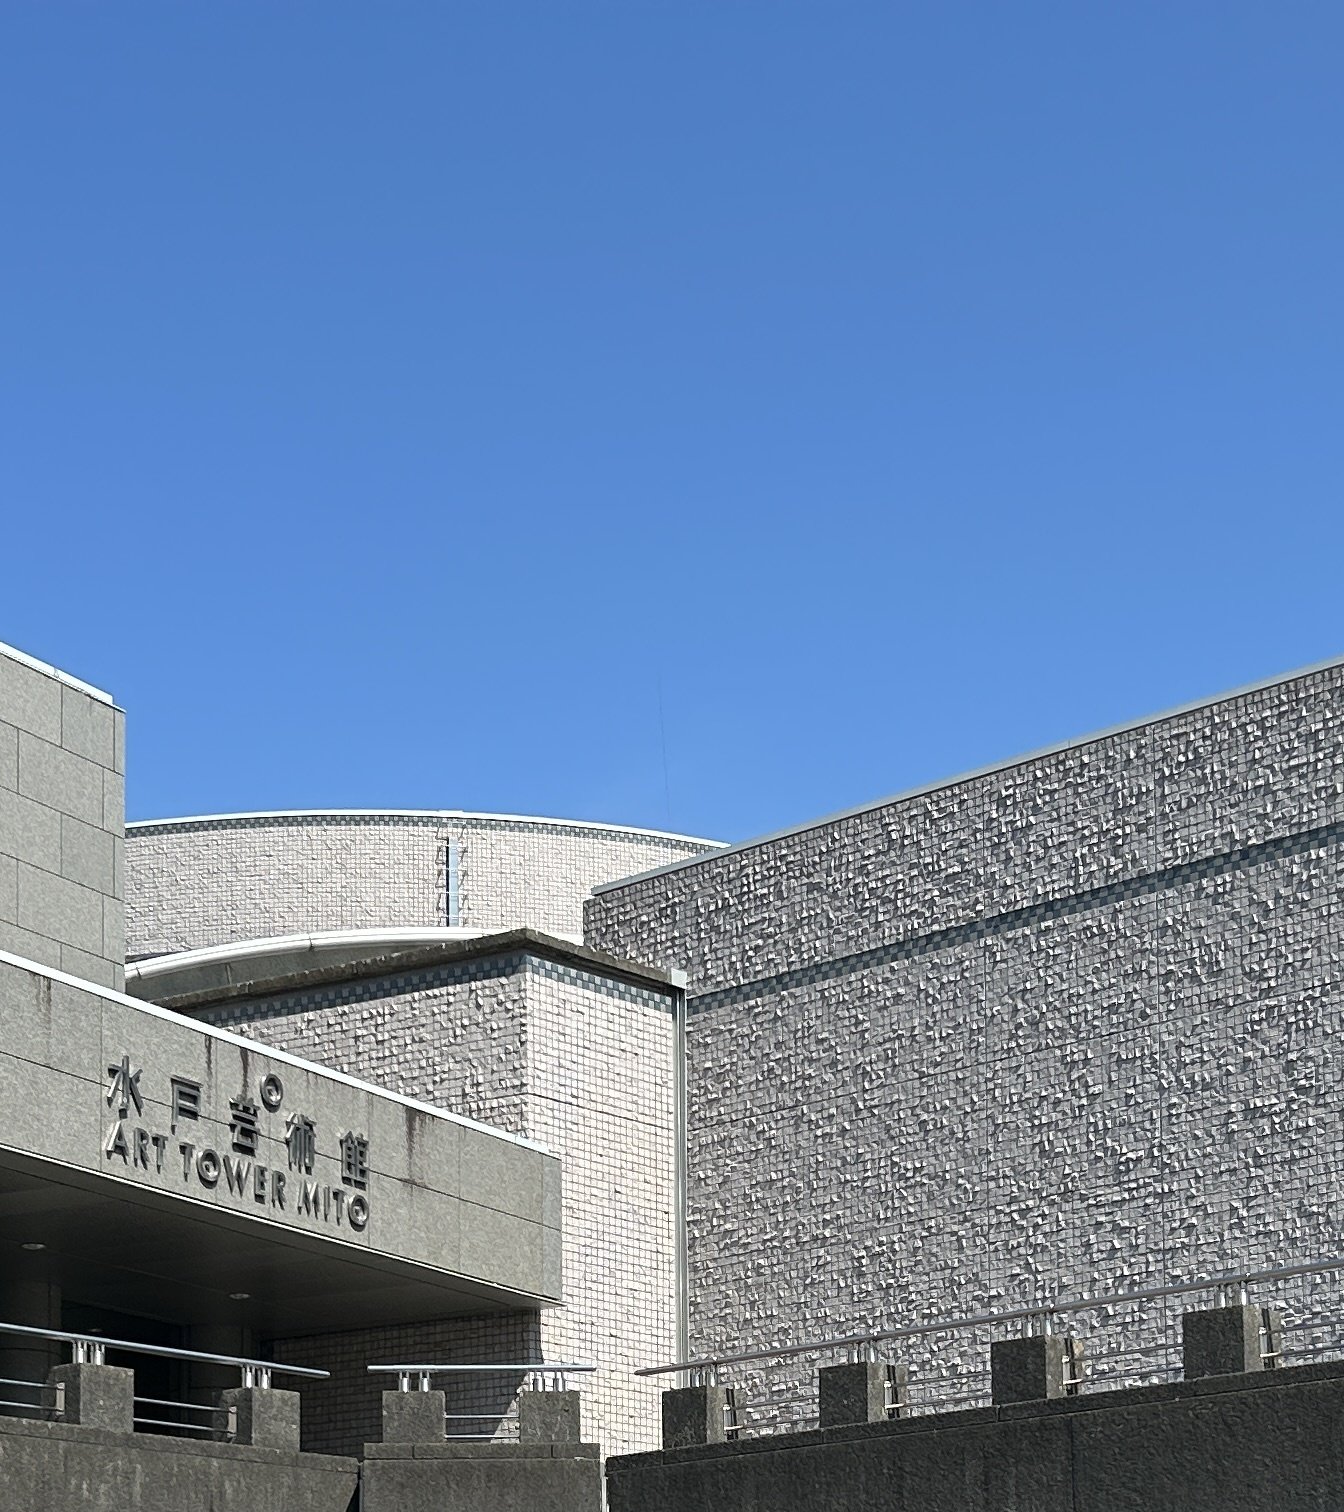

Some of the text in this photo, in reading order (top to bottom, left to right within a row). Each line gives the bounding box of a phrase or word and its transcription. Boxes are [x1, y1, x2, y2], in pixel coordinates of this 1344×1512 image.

[106, 1121, 370, 1232] ART TOWER MITO
